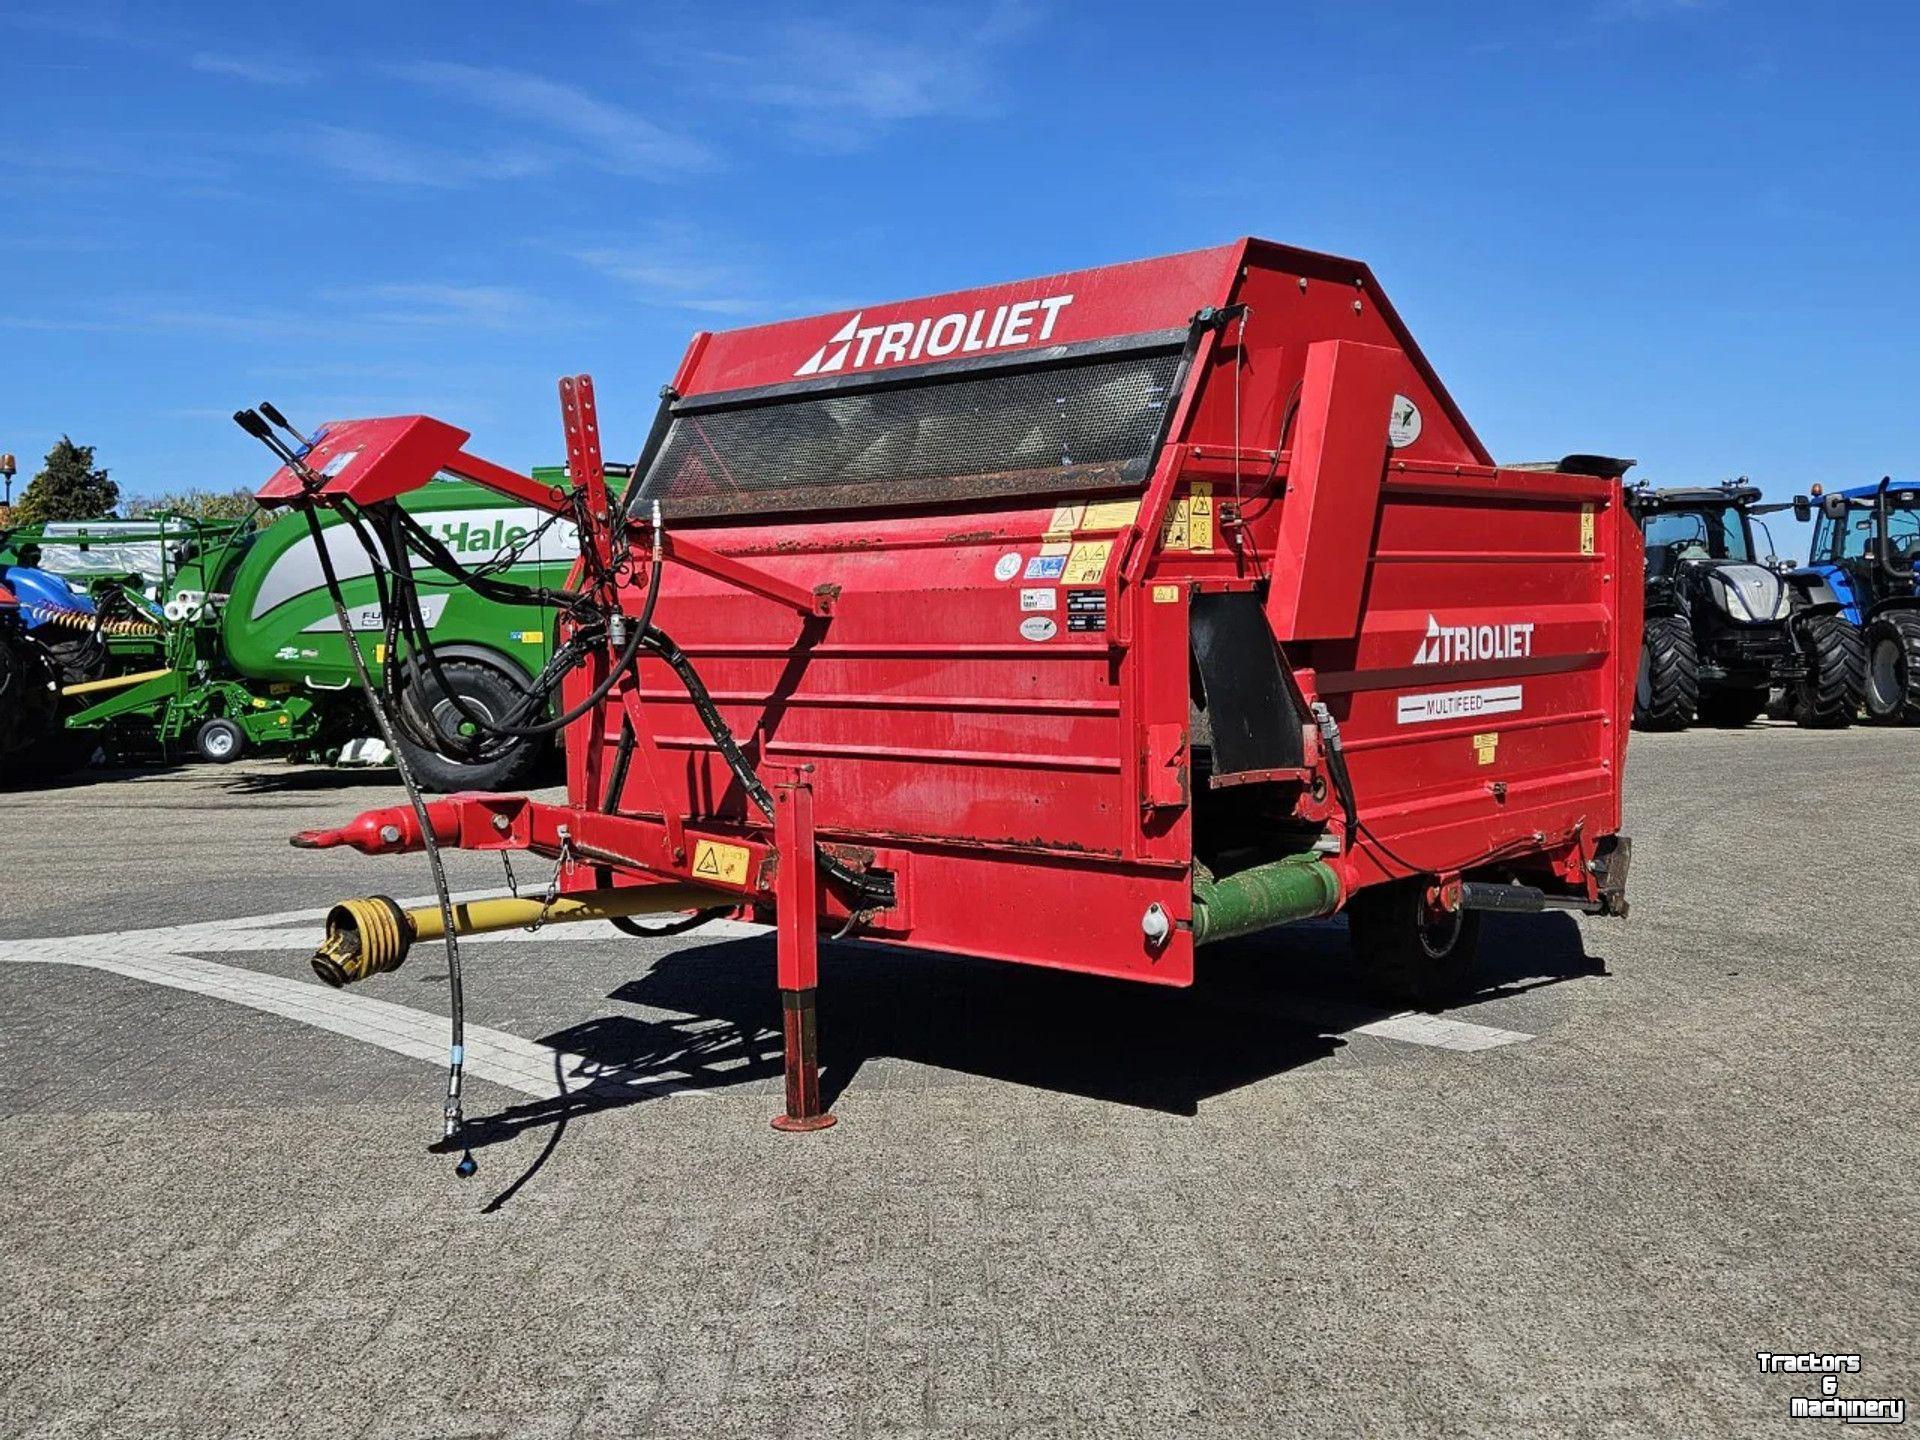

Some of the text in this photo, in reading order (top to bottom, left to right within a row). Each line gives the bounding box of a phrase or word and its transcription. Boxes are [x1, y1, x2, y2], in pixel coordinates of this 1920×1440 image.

[853, 294, 1074, 368] TRIOLIET
[1440, 623, 1534, 662] TRIOLIET
[1426, 695, 1483, 715] MULTIFEED
